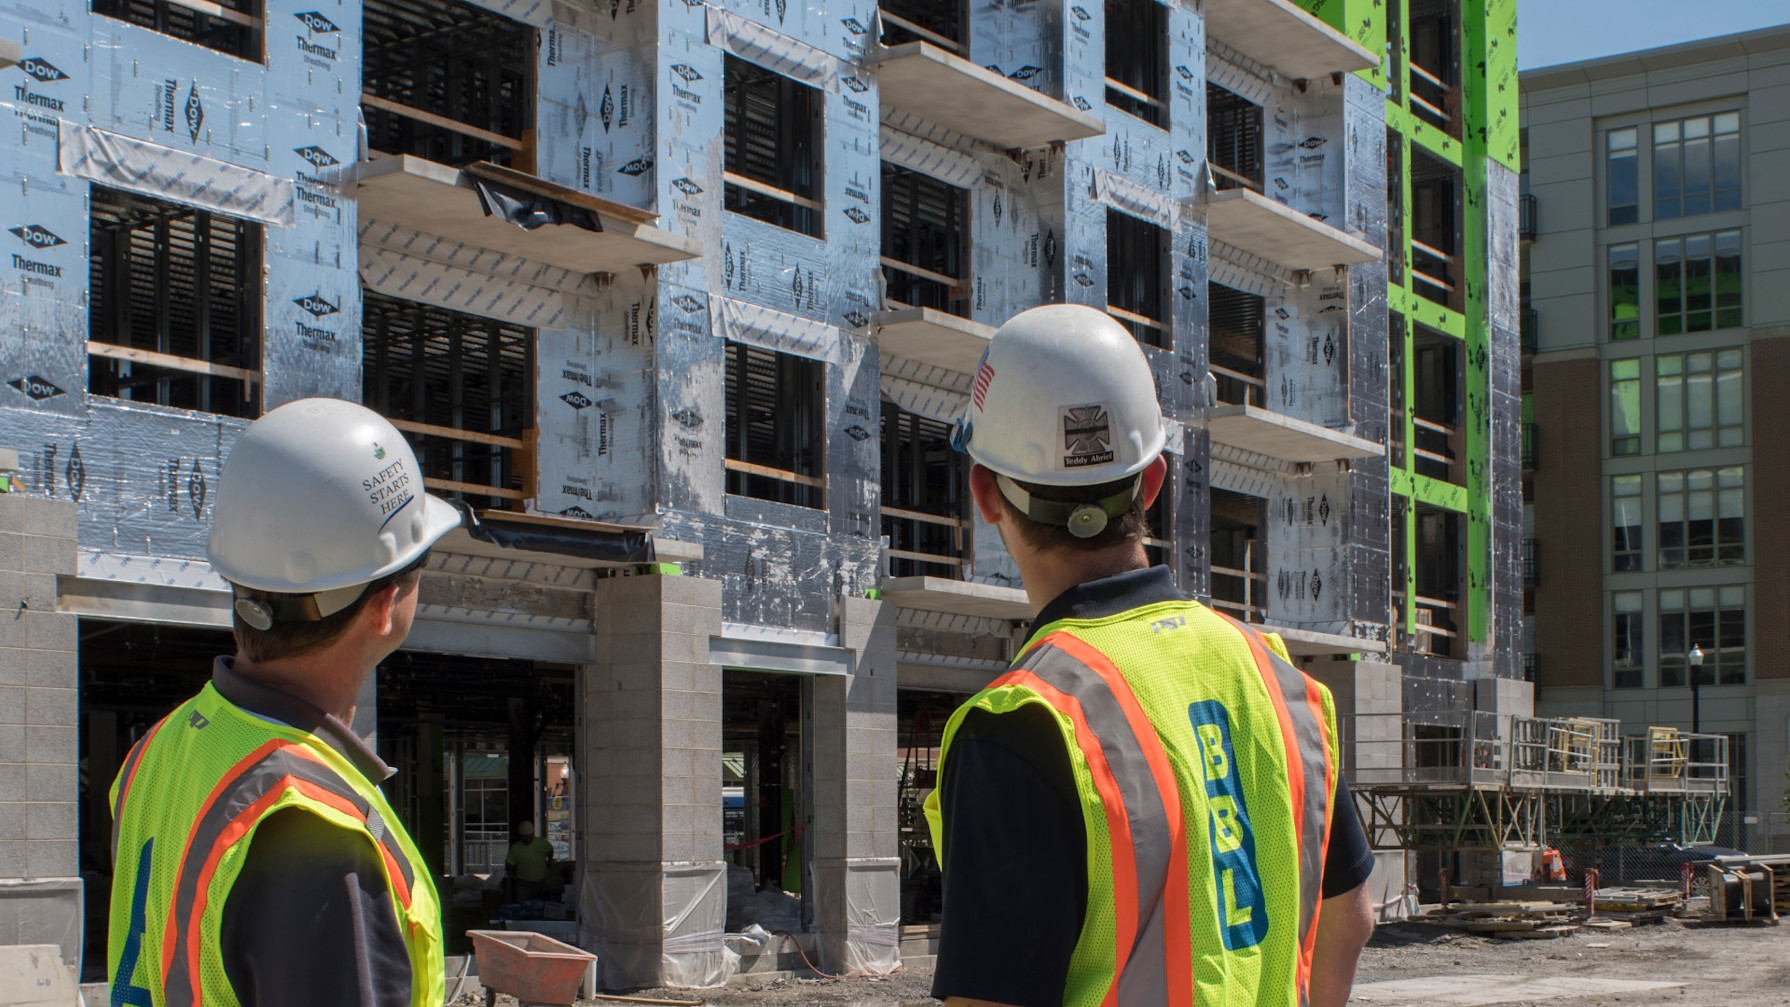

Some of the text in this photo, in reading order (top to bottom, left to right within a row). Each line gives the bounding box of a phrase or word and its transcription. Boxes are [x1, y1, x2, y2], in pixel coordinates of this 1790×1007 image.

[305, 13, 332, 31] DOW
[847, 21, 863, 33] DOW
[296, 35, 336, 61] Thermax
[25, 60, 60, 79] DOW
[678, 65, 698, 80] DOW
[1016, 69, 1037, 78] DOW
[14, 85, 64, 112] Thermax
[672, 83, 701, 104] Thermax
[165, 79, 177, 133] Thermax
[189, 96, 199, 133] DOW
[619, 84, 628, 128] Thermax
[304, 148, 331, 165] DOW
[625, 160, 647, 173] DOW
[583, 147, 591, 189] Thermax
[296, 186, 336, 208] Thermax
[25, 228, 57, 245] DOW
[12, 253, 62, 278] Thermax
[304, 299, 332, 313] DOW
[296, 321, 337, 343] Thermax
[631, 302, 640, 346] Thermax
[23, 381, 55, 396] DOW
[562, 370, 592, 387] Thermax
[566, 395, 588, 407] DOW
[599, 413, 607, 457] Thermax
[1066, 456, 1088, 465] Teddy
[362, 458, 404, 491] SAFETY
[192, 472, 202, 508] DOW
[370, 473, 410, 504] STARTS
[562, 485, 592, 500] Thermax
[381, 489, 411, 515] HERE
[1197, 723, 1253, 928] BBL
